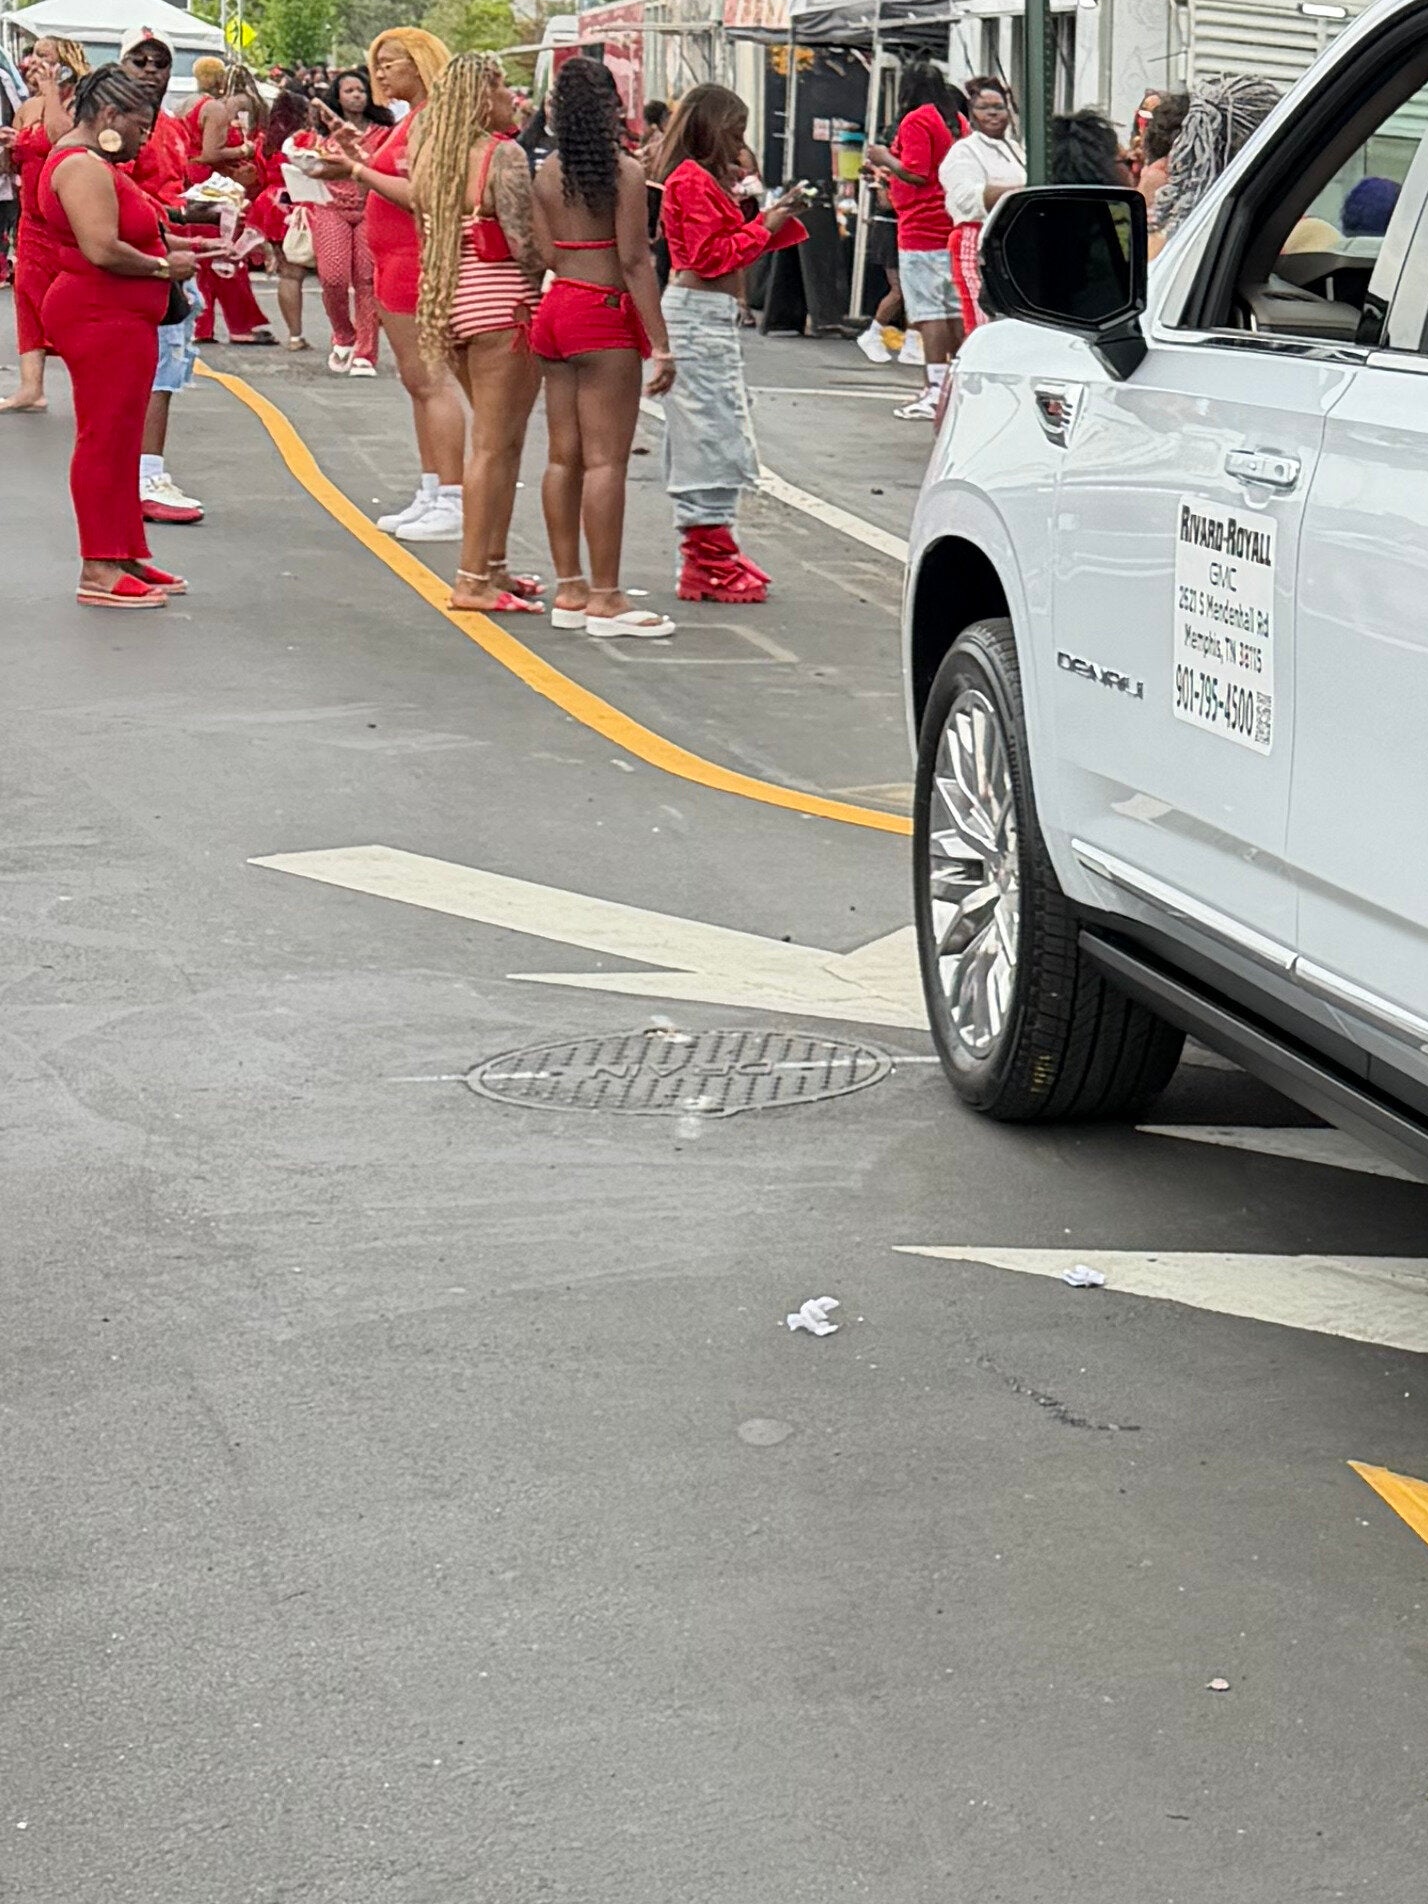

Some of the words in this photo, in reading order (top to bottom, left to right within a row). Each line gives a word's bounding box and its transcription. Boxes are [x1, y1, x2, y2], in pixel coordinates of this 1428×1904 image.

[1209, 562, 1237, 592] GMC
[1225, 637, 1237, 664] TN
[1057, 651, 1144, 700] DENALI
[1175, 663, 1255, 737] 901-795-4500
